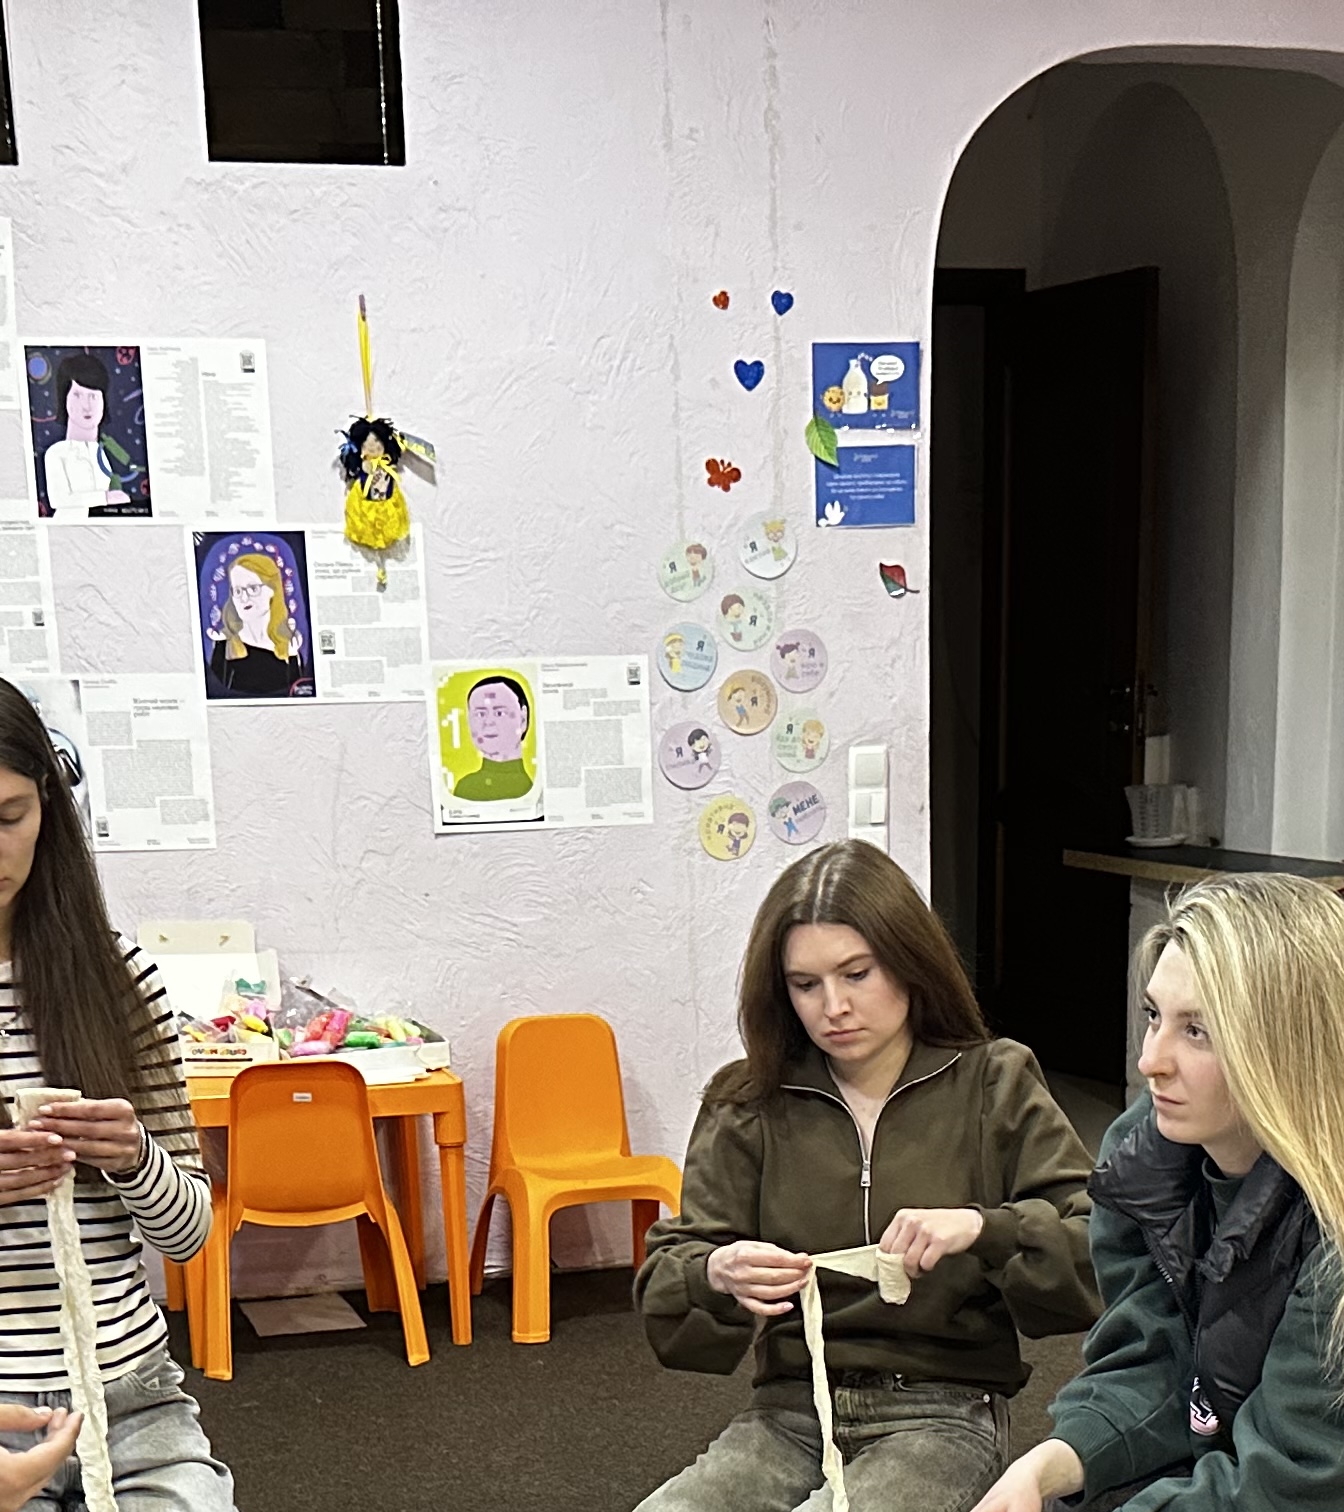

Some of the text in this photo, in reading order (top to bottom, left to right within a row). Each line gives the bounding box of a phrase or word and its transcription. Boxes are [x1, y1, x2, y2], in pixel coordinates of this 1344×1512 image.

[749, 541, 758, 553] Я
[668, 561, 677, 573] Я
[749, 615, 758, 627] Я
[696, 640, 705, 652] Я
[808, 647, 816, 658] Я
[750, 696, 758, 707] Я
[786, 724, 794, 734] Я
[675, 747, 684, 758] Я
[792, 794, 820, 816] МЕНЕ
[717, 823, 725, 834] Я
